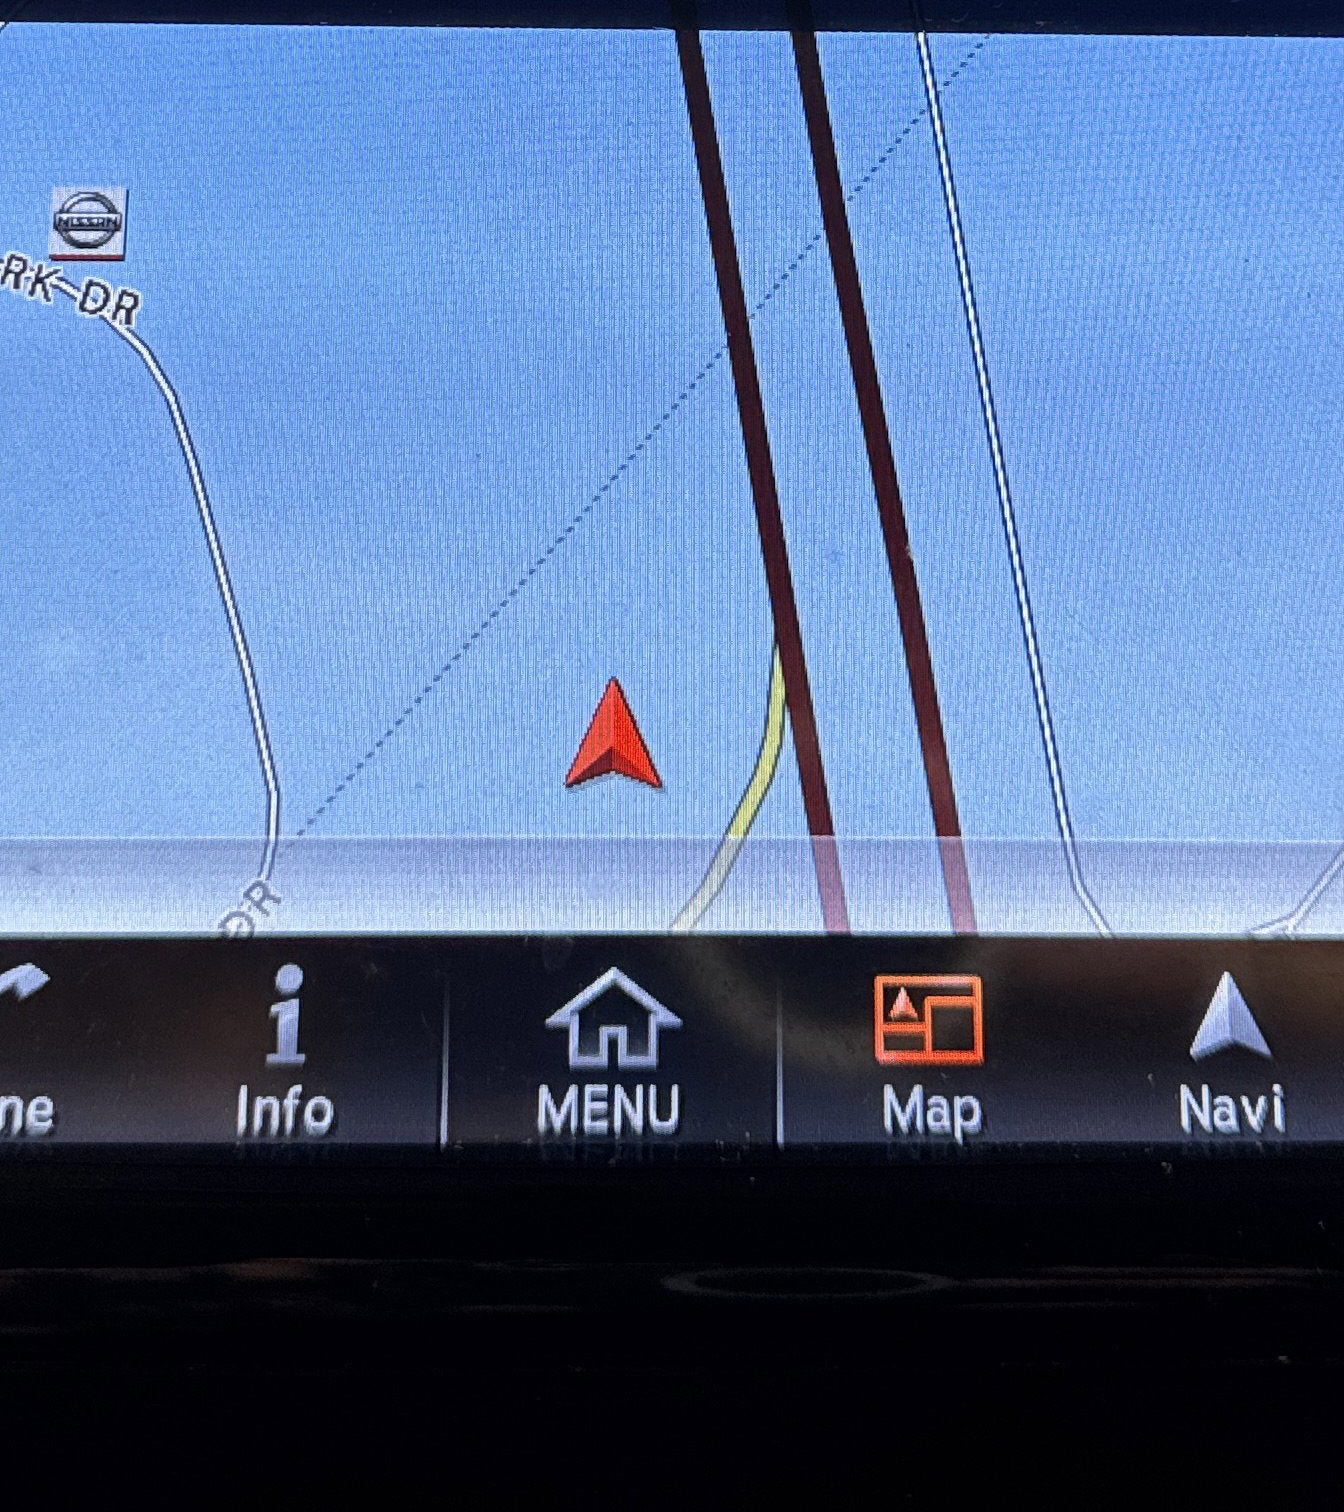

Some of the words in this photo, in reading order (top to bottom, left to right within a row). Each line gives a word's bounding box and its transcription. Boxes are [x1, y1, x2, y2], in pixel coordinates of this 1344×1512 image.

[78, 278, 142, 326] DR
[236, 1083, 335, 1136] Info
[536, 1083, 680, 1135] MENU
[882, 1083, 983, 1145] Map
[1179, 1082, 1286, 1134] Navi
